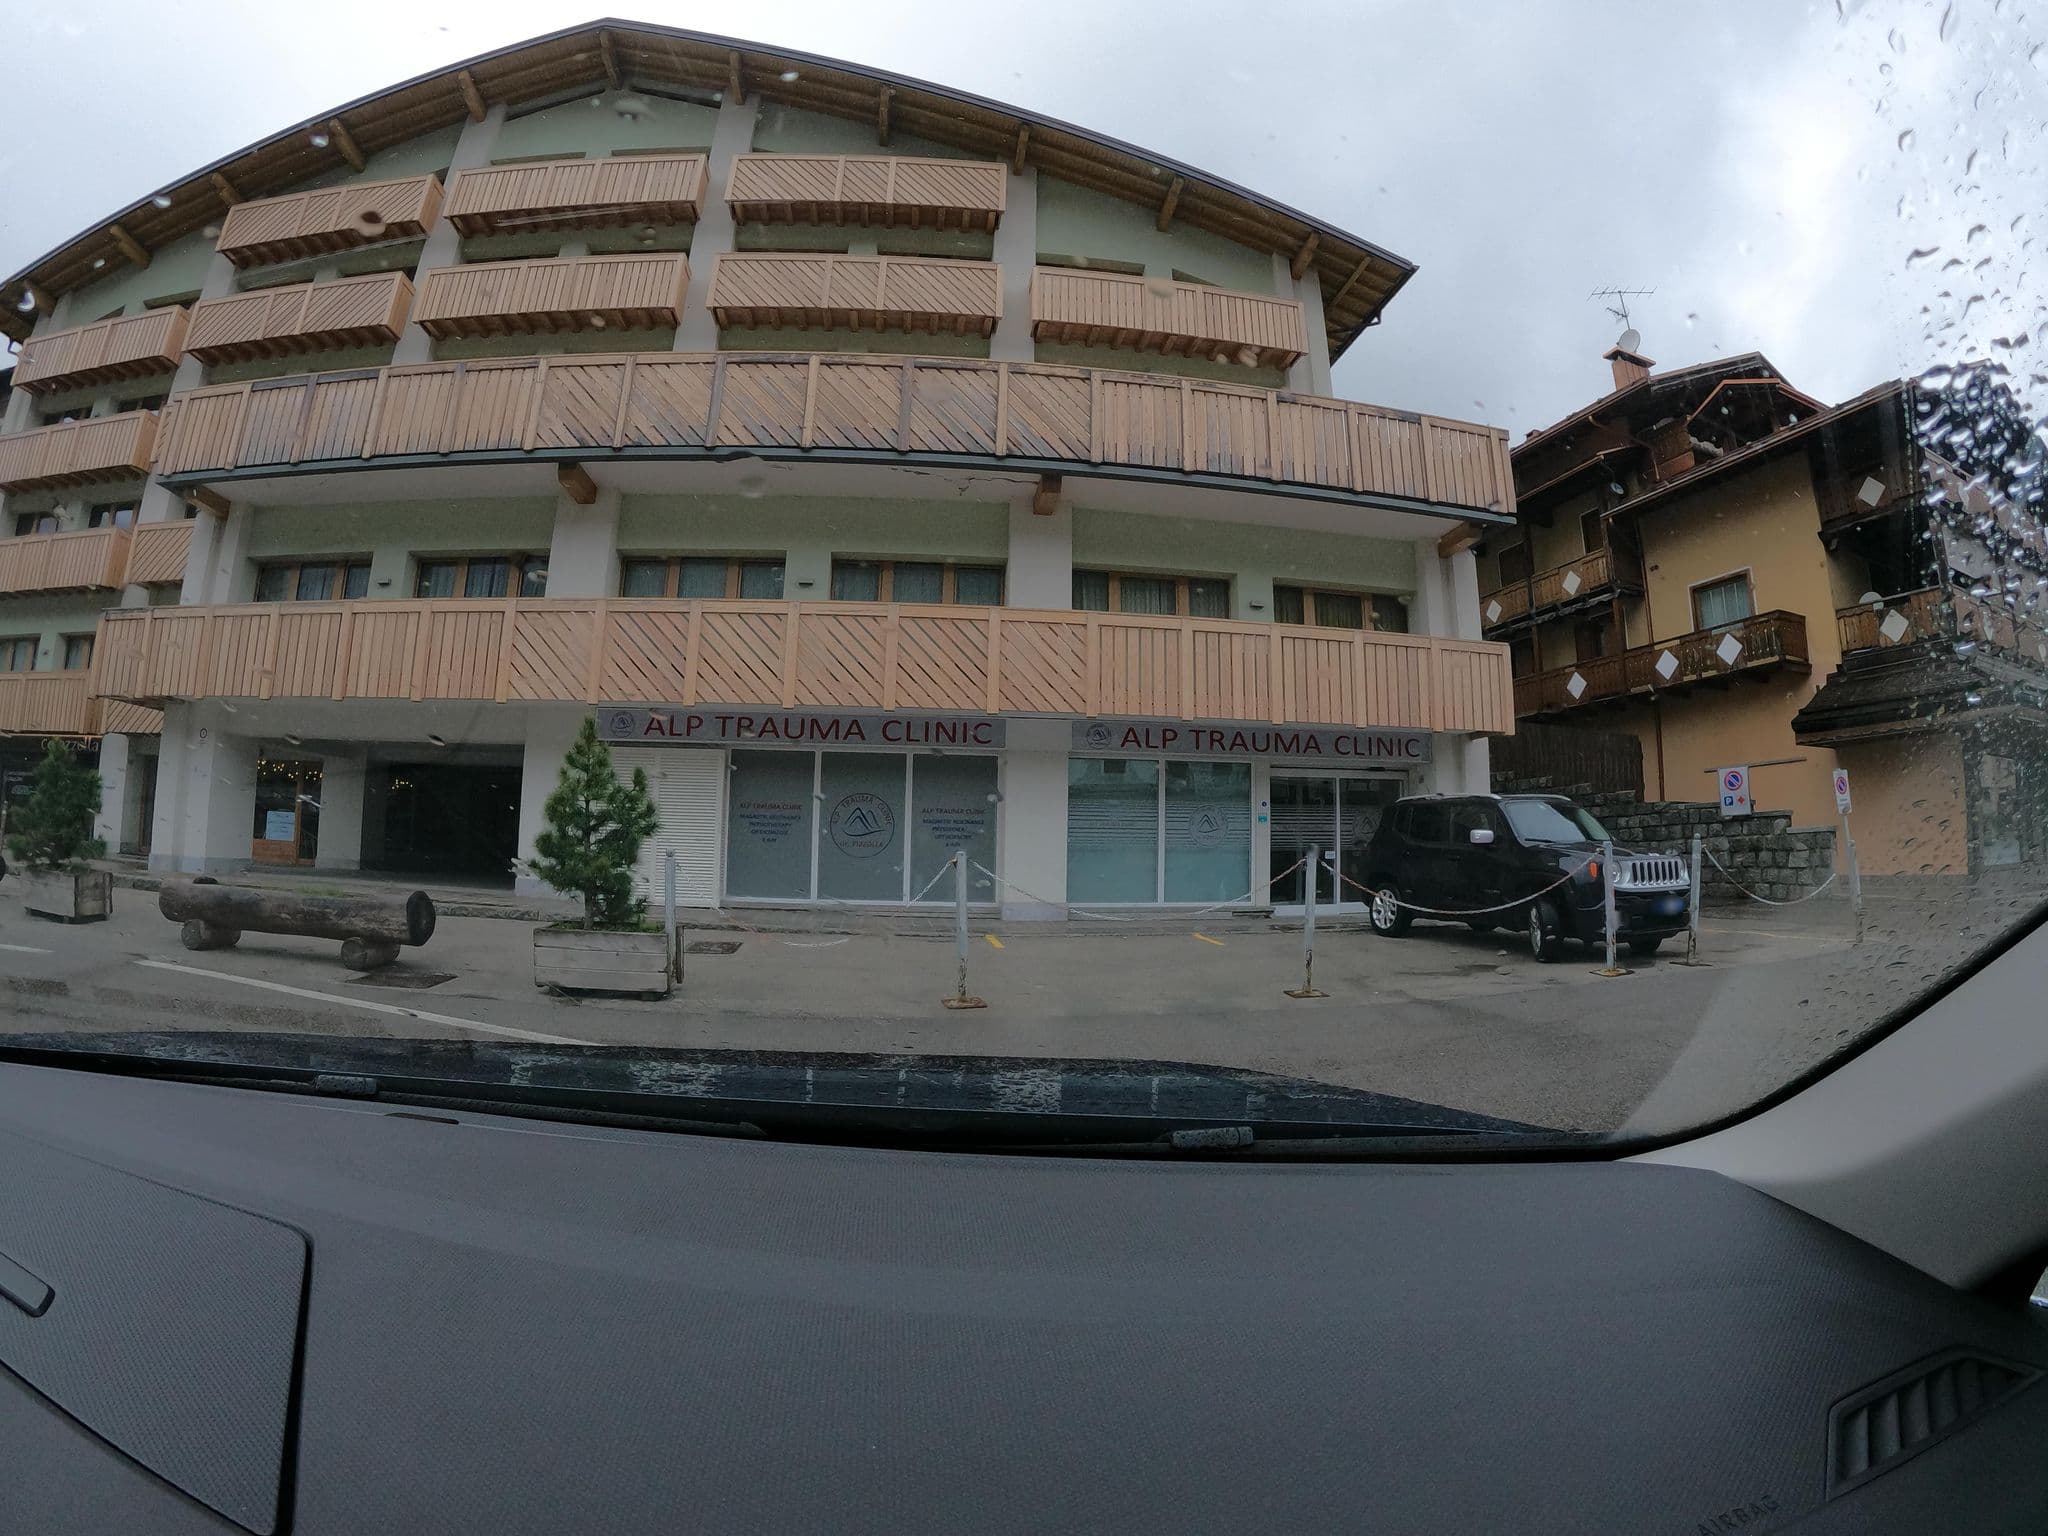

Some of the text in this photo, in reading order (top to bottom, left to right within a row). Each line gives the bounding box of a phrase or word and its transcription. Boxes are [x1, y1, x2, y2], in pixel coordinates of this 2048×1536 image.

[643, 715, 704, 737] ALP
[715, 716, 866, 741] TRAUMA
[882, 719, 993, 744] CLINIC
[1121, 726, 1178, 749] ALP
[1189, 729, 1322, 754] TRAUMA
[1334, 735, 1421, 758] CLINIC
[1697, 1494, 1780, 1536] AIRBAG
